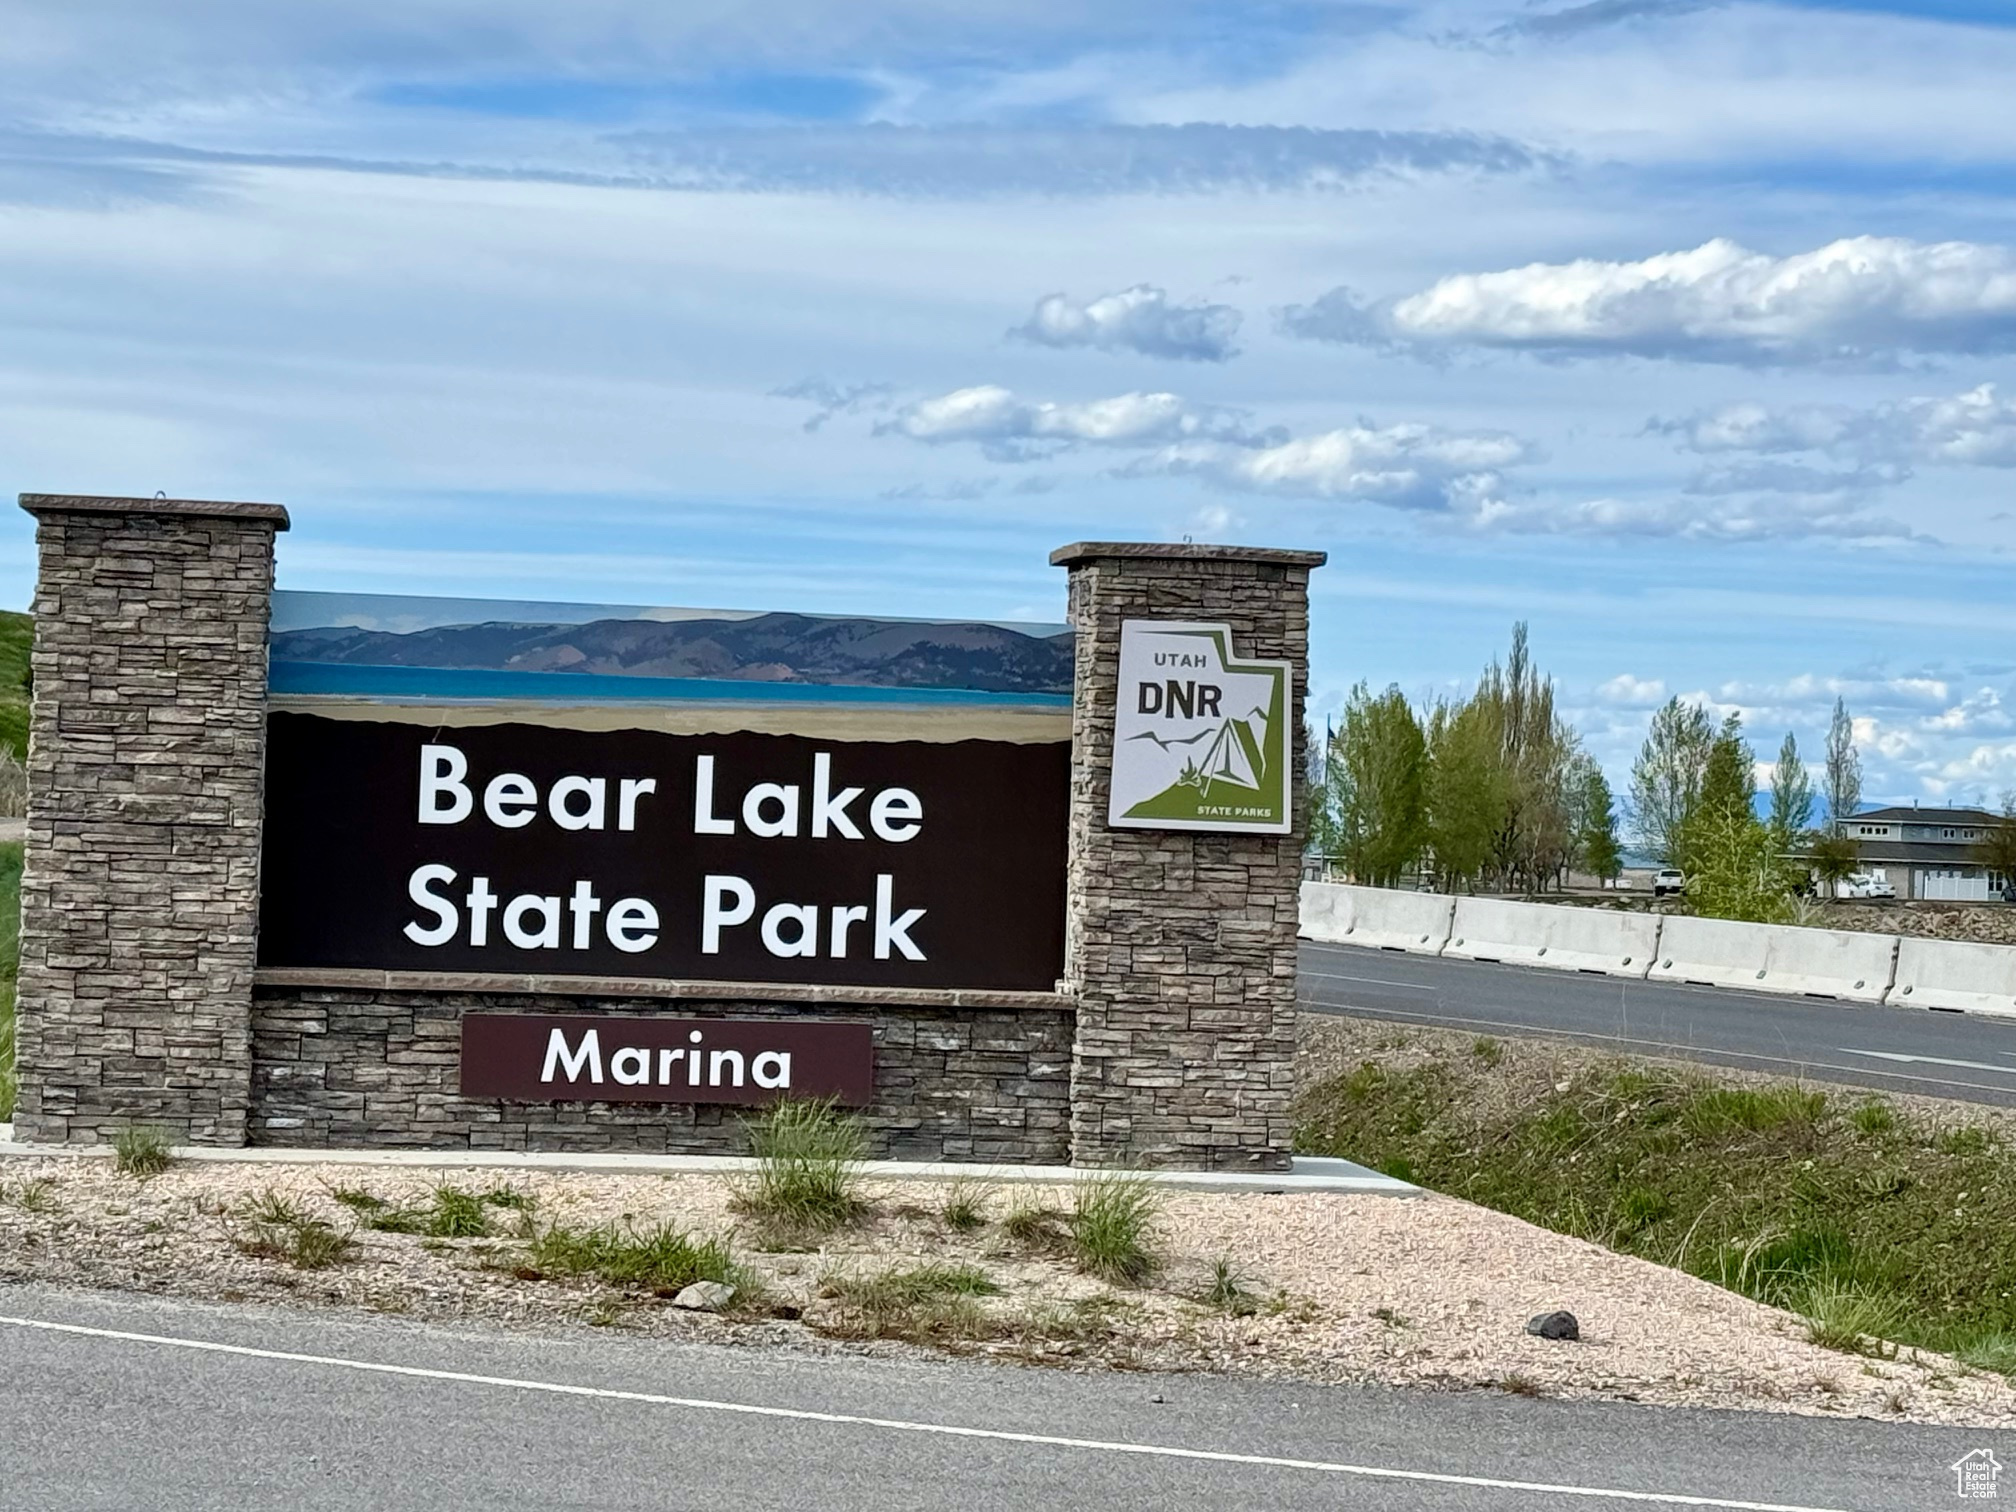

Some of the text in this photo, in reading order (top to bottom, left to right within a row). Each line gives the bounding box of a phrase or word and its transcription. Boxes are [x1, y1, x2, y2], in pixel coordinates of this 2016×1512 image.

[1154, 652, 1207, 668] UTAH
[1138, 679, 1222, 719] DNR
[418, 744, 923, 842] Bear Lake
[1197, 805, 1272, 818] STATE PARKS
[403, 863, 928, 961] State Park
[540, 1028, 791, 1089] Marina
